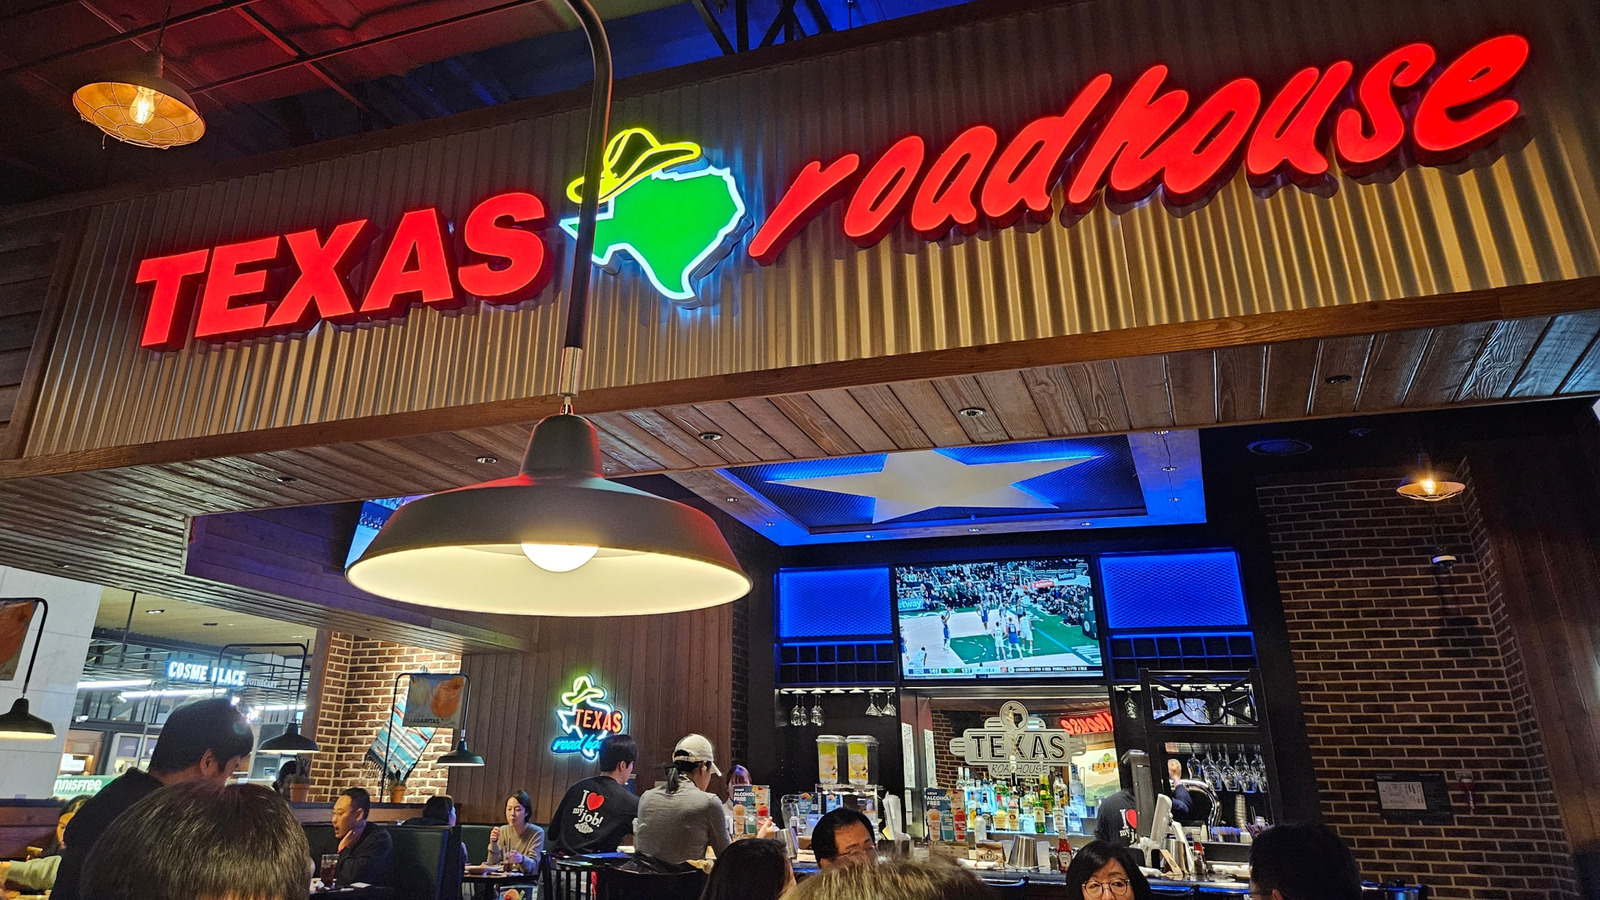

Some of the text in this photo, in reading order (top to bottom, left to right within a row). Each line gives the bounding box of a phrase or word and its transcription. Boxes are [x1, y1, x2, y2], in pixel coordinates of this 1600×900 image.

[135, 34, 1529, 347] TEXAS roadhouse
[898, 600, 922, 609] etway
[168, 661, 209, 681] COSME
[575, 708, 622, 733] TEXAS
[553, 734, 603, 751] roadho
[969, 734, 1066, 760] TEXAS
[578, 789, 590, 808] I
[572, 808, 585, 816] my
[578, 810, 604, 828] job!
